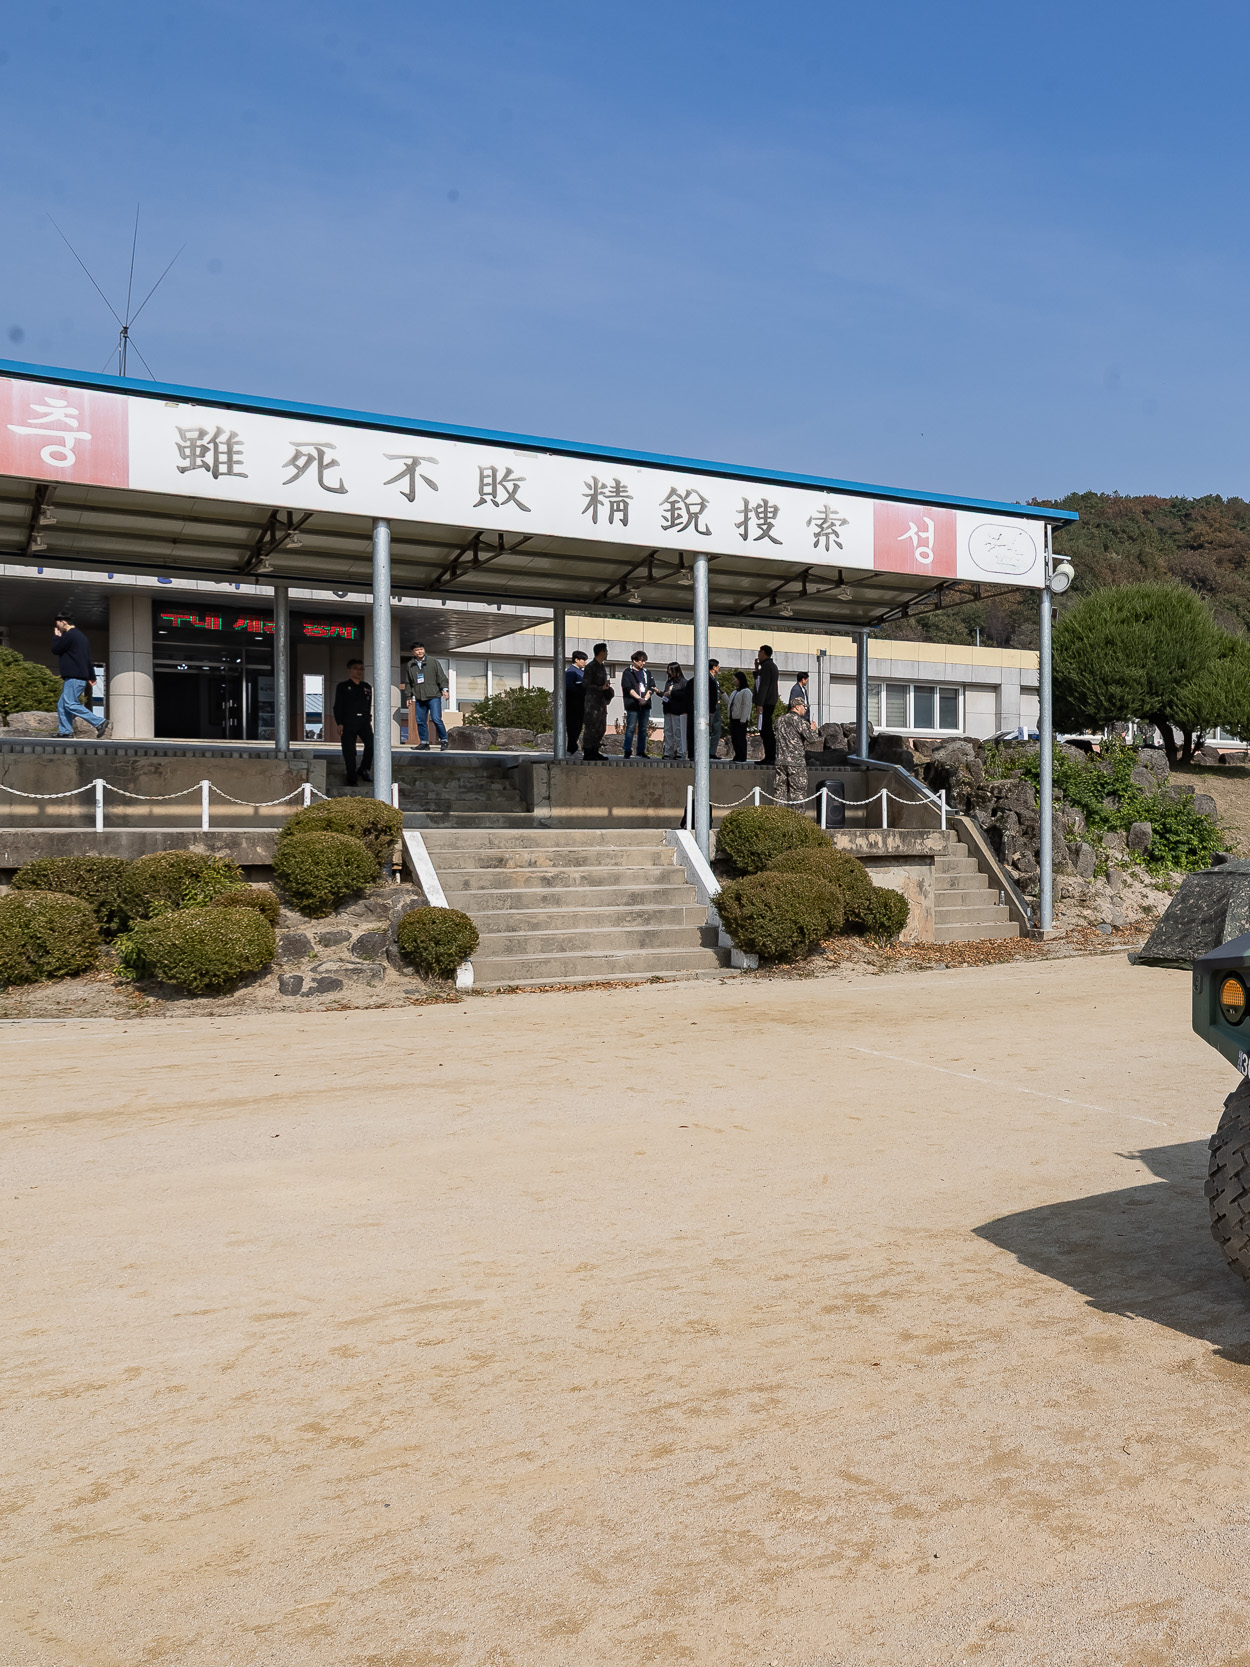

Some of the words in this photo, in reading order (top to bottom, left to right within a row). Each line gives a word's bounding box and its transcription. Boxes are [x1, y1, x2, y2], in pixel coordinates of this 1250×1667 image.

[6, 396, 92, 467] 충
[175, 427, 532, 513] 雖死不敗
[581, 475, 850, 552] 精銳搜索
[897, 516, 935, 564] 성
